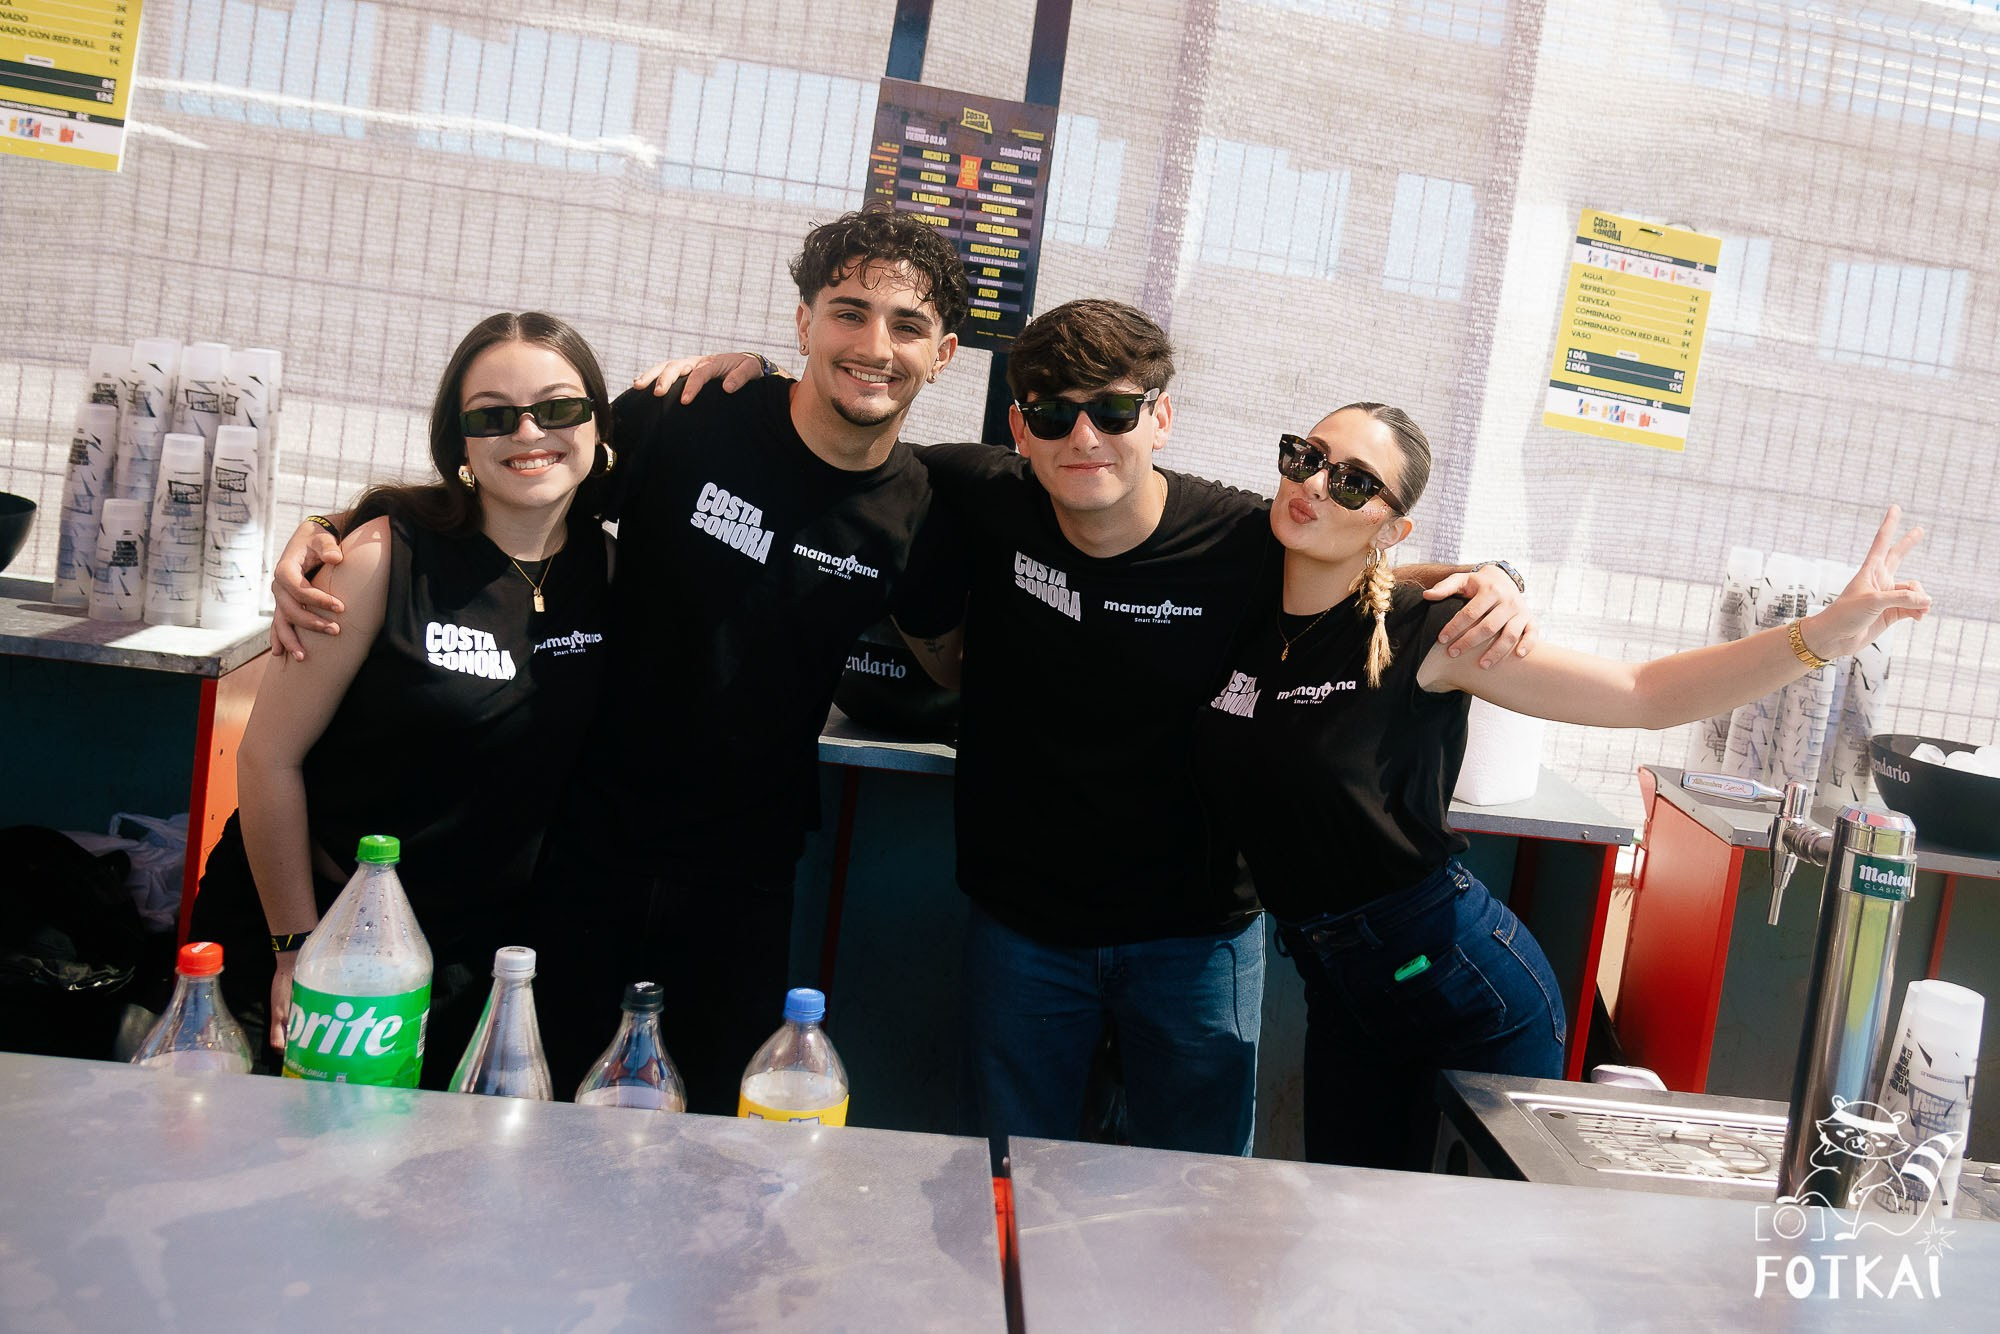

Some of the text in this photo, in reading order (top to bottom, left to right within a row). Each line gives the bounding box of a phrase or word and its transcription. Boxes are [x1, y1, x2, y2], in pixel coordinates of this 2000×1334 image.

[28, 30, 50, 40] CON
[1594, 216, 1616, 230] COSTA
[970, 243, 1000, 256] UNIVERSO
[1008, 248, 1020, 259] SET
[1582, 272, 1603, 280] AGUA
[1578, 295, 1610, 308] CERVEZA
[1580, 283, 1616, 296] REFRESCO
[1575, 306, 1622, 321] COMBINADO
[1572, 330, 1592, 340] VASO
[1573, 318, 1620, 333] COMBINADO
[1620, 327, 1637, 337] CON
[1638, 332, 1652, 340] RED
[696, 482, 764, 528] COSTA
[690, 511, 774, 564] SONORA
[792, 544, 879, 579] mamajuana
[1014, 550, 1067, 588] COSTA
[1015, 574, 1081, 622] SONORA
[1104, 600, 1202, 620] mamajuana
[426, 622, 498, 652] COSTA
[534, 630, 603, 654] majuaa
[428, 650, 517, 680] SONORA
[1221, 670, 1258, 696] STA
[1210, 688, 1262, 718] SNOA
[1860, 864, 1912, 888] Mahou
